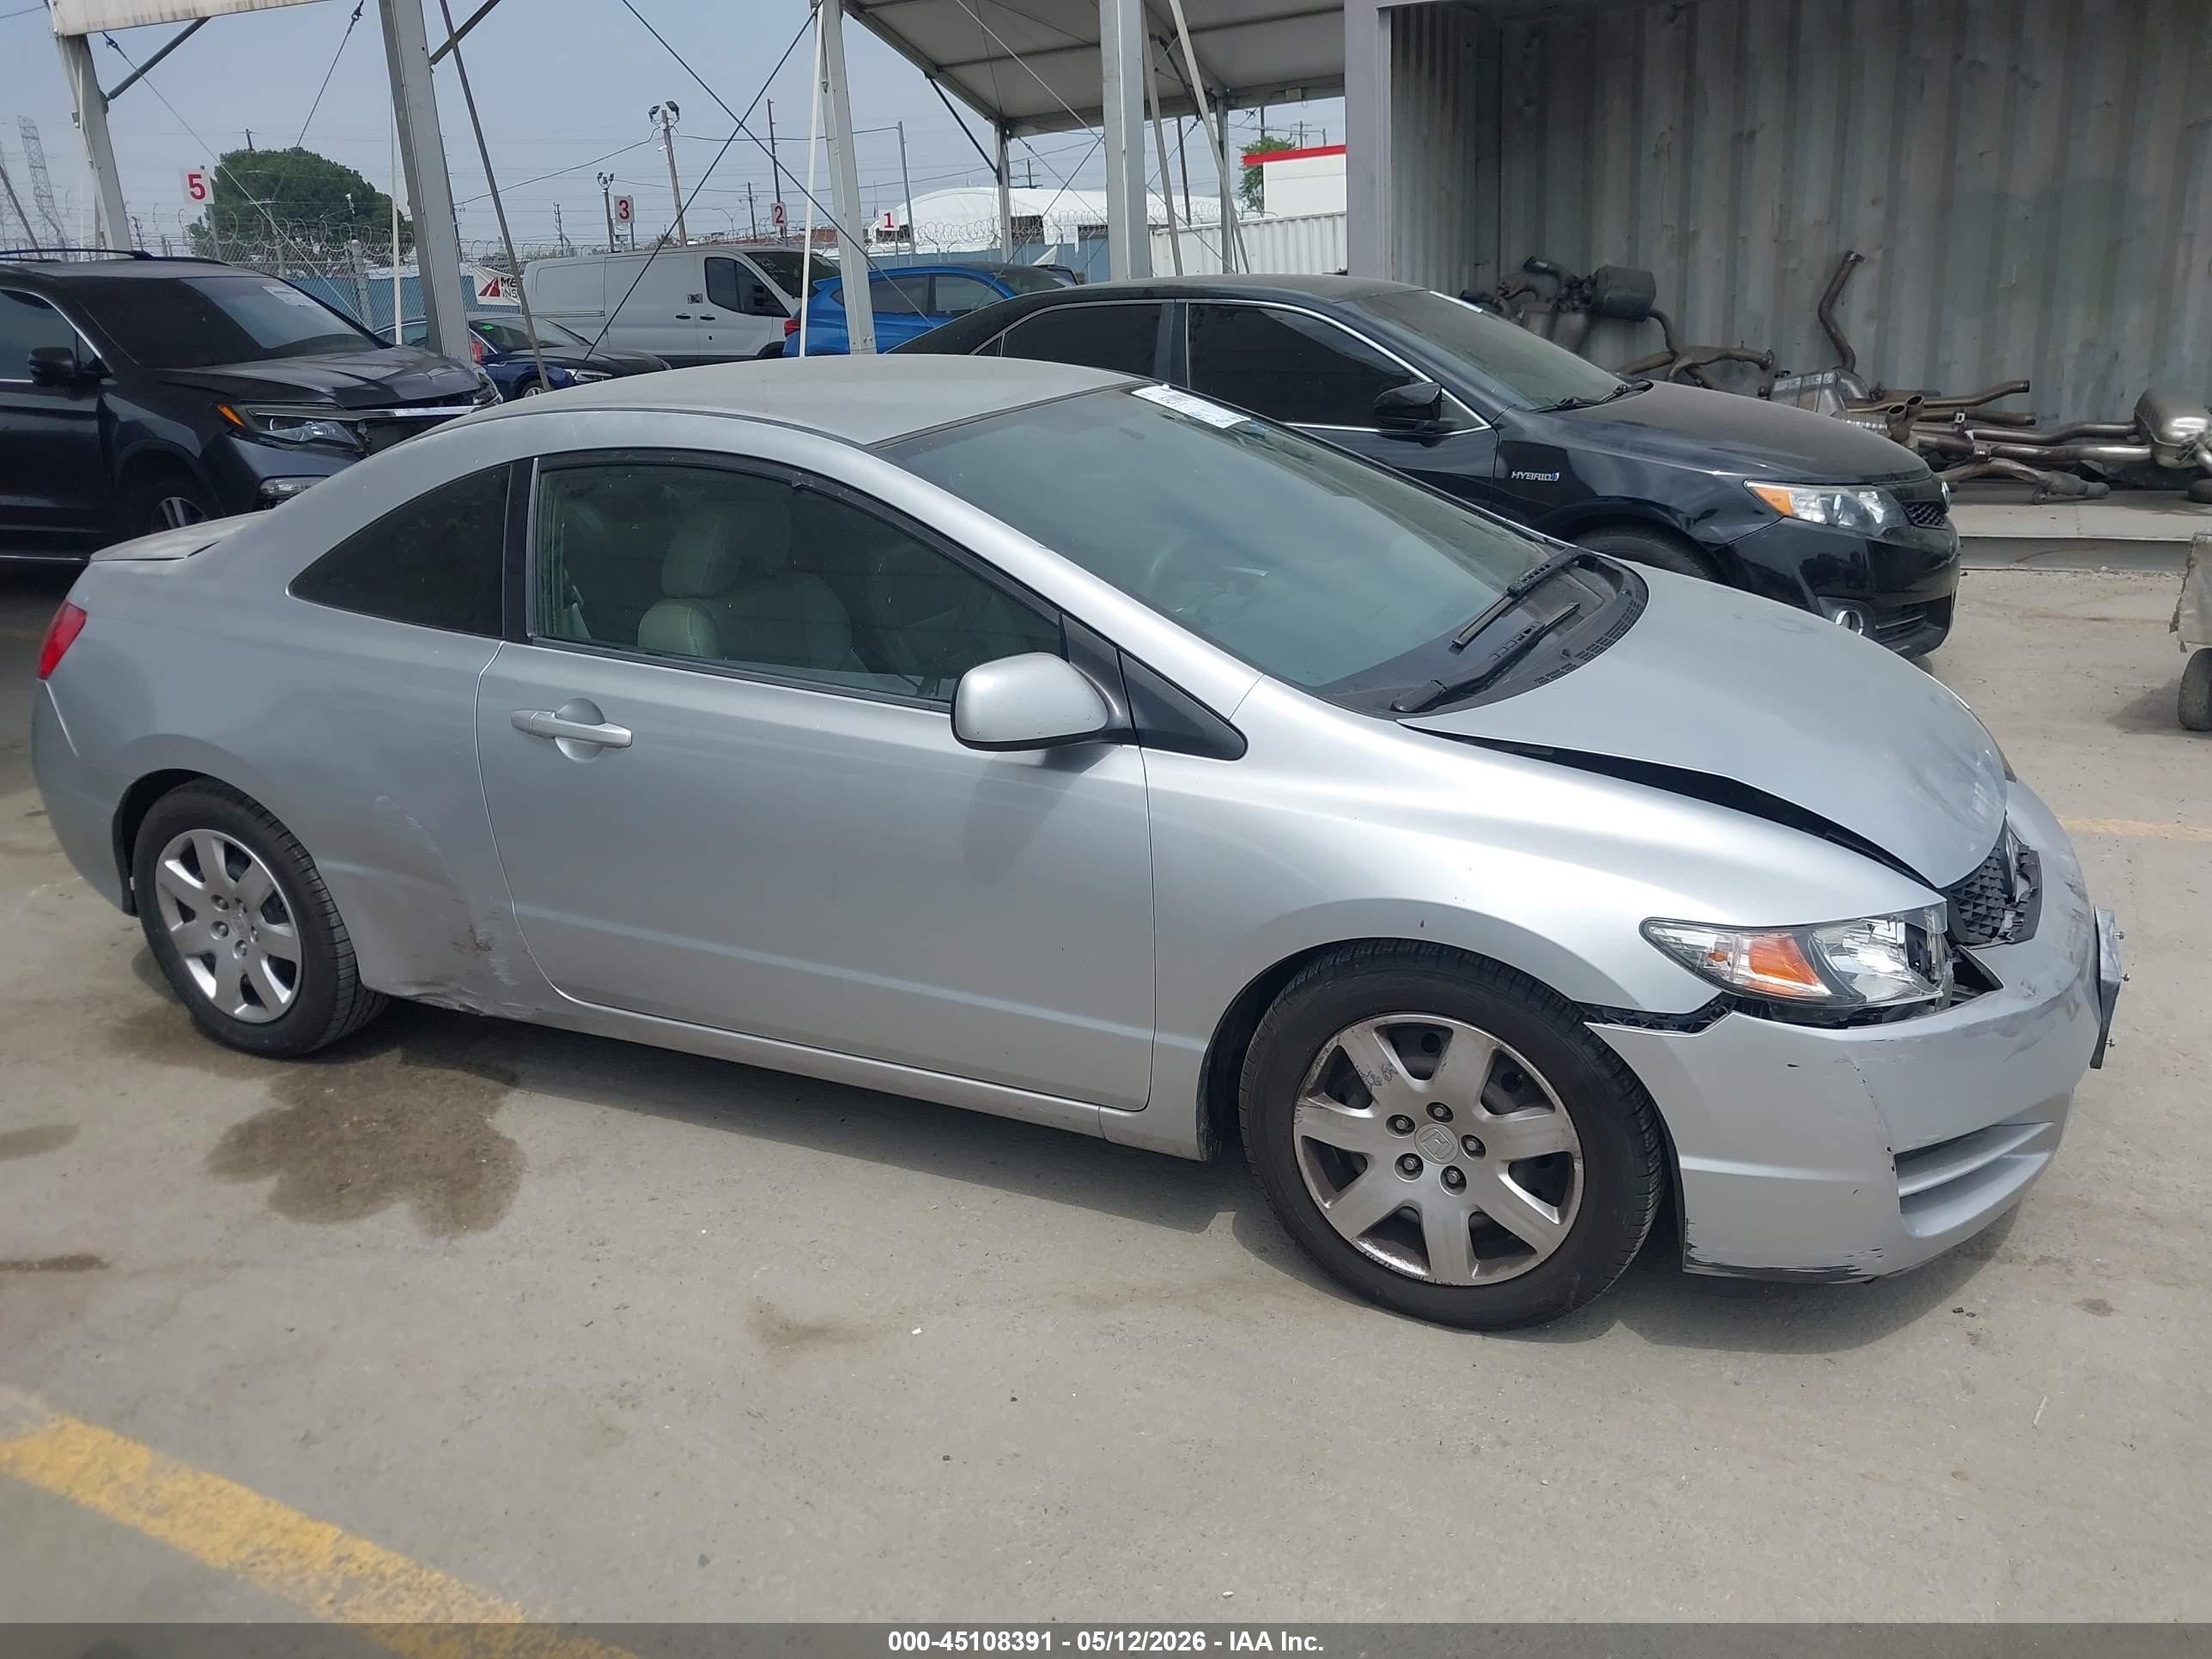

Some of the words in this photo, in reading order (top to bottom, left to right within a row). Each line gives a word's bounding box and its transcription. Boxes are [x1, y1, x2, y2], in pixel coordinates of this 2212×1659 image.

[188, 173, 206, 200] 5
[619, 199, 629, 220] 3
[775, 205, 784, 224] 2
[884, 212, 894, 228] 1
[1511, 471, 1553, 481] HYBRID
